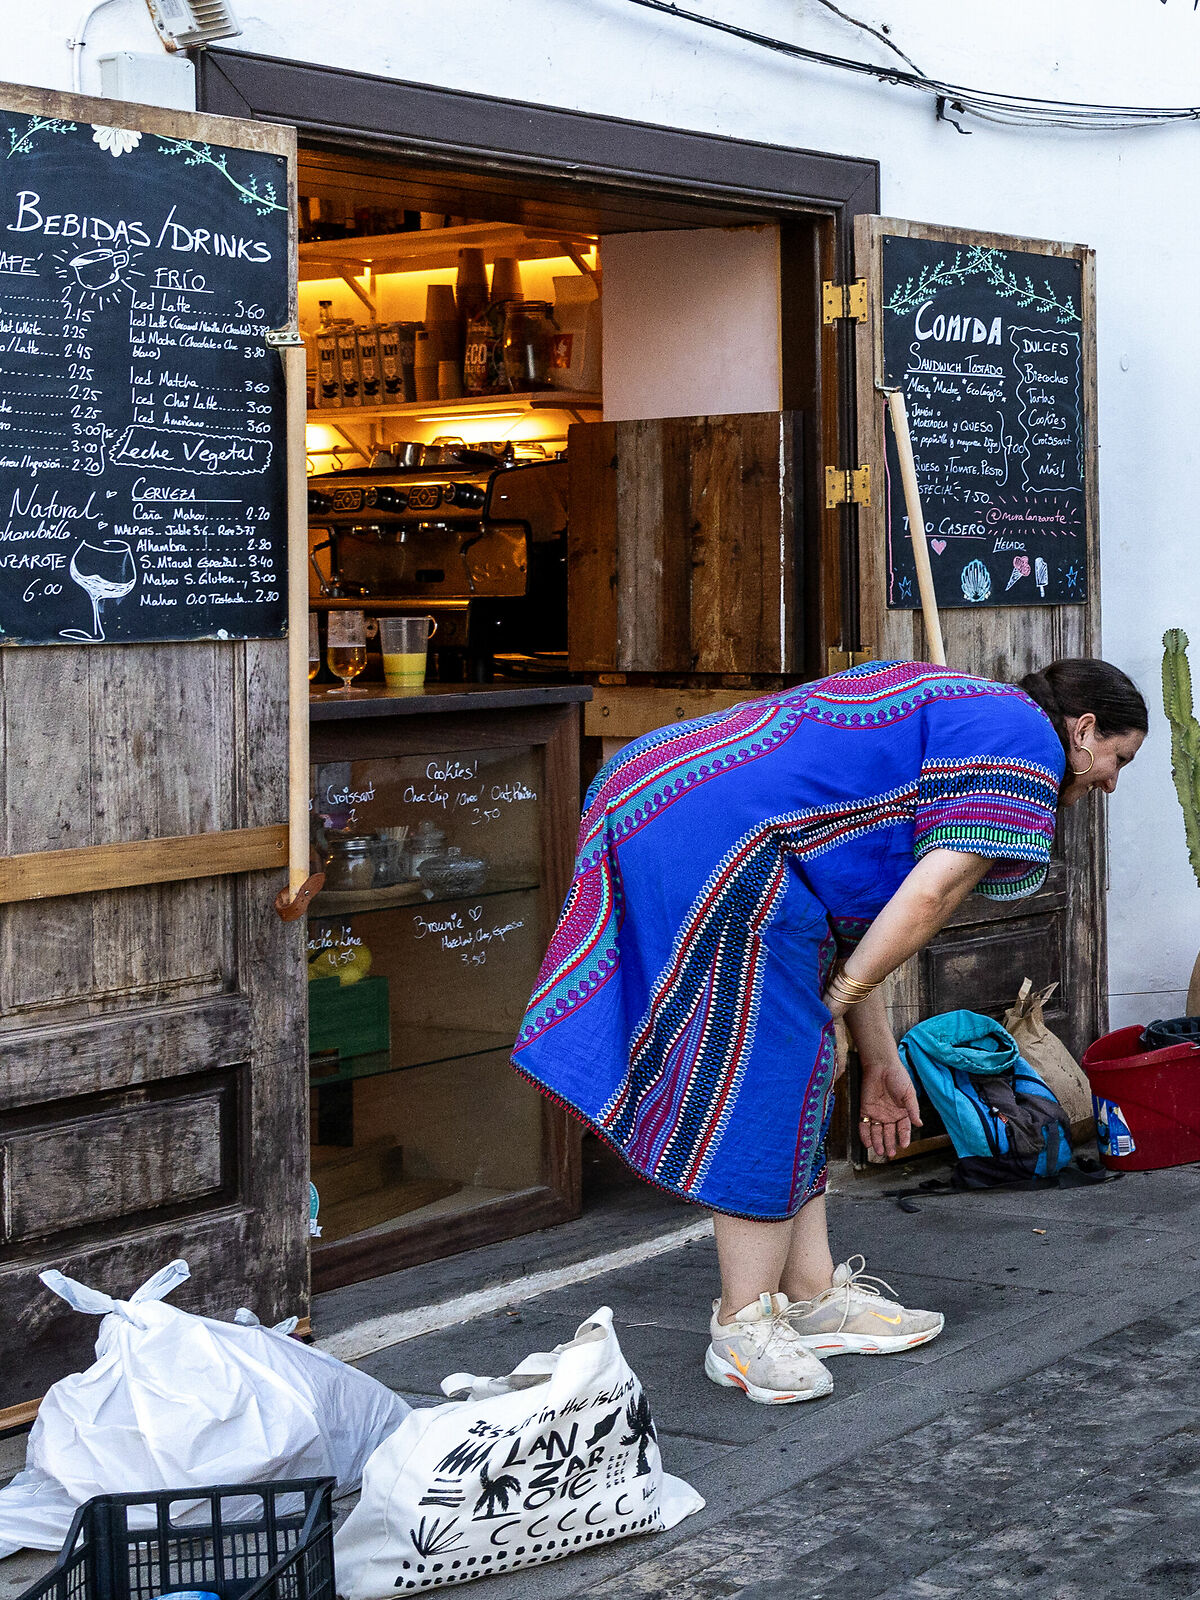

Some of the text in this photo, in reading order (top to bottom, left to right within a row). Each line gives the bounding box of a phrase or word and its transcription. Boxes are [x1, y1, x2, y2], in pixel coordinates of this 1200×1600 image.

[7, 191, 272, 262] BEBIDAS /DRINKS
[0, 251, 43, 272] AFÉ
[154, 268, 206, 290] FRÍO
[62, 303, 95, 322] 2.15
[131, 291, 265, 319] Iced Latte 3.60
[130, 310, 146, 327] Iced
[915, 300, 1002, 346] COMIDA
[62, 325, 88, 339] 2.25
[64, 344, 93, 359] 2.45
[244, 347, 265, 358] 3.80
[1023, 338, 1069, 356] DULCES
[907, 342, 1003, 375] SANDWICH TOSTADO
[68, 363, 94, 380] 2.25
[130, 366, 154, 385] Iced
[159, 371, 199, 388] Matcha
[68, 385, 102, 401] 2.25
[131, 387, 155, 405] Iced
[163, 392, 190, 408] Chai
[193, 393, 218, 410] Latte
[1026, 388, 1055, 404] Tartas
[70, 405, 102, 419] 2.25
[133, 407, 154, 423] Iced
[1028, 409, 1067, 429] Cookies
[72, 423, 100, 435] 3.00
[960, 420, 993, 433] QUESO
[71, 440, 97, 453] 3.00
[117, 429, 253, 471] Leche Vegetal
[71, 457, 99, 472] 2.20
[981, 460, 1004, 477] PESTO
[132, 477, 196, 500] CERVEZA
[917, 484, 990, 504] SPECIAL 7.50
[133, 503, 270, 520] Caña Mahou 2.20
[938, 517, 986, 535] CASERO
[136, 538, 272, 552] Alhambra 2.80
[248, 555, 273, 568] 3.40
[198, 571, 235, 585] Gluten
[252, 571, 276, 583] 3.00
[23, 579, 62, 602] 6.00
[256, 590, 279, 602] 2.80
[426, 760, 478, 781] Cookies!
[413, 912, 465, 939] Brownie
[538, 1406, 556, 1424] in
[560, 1397, 589, 1417] the
[502, 1422, 579, 1469] LAN
[528, 1446, 605, 1489] ZAR
[523, 1469, 598, 1510] OTE
